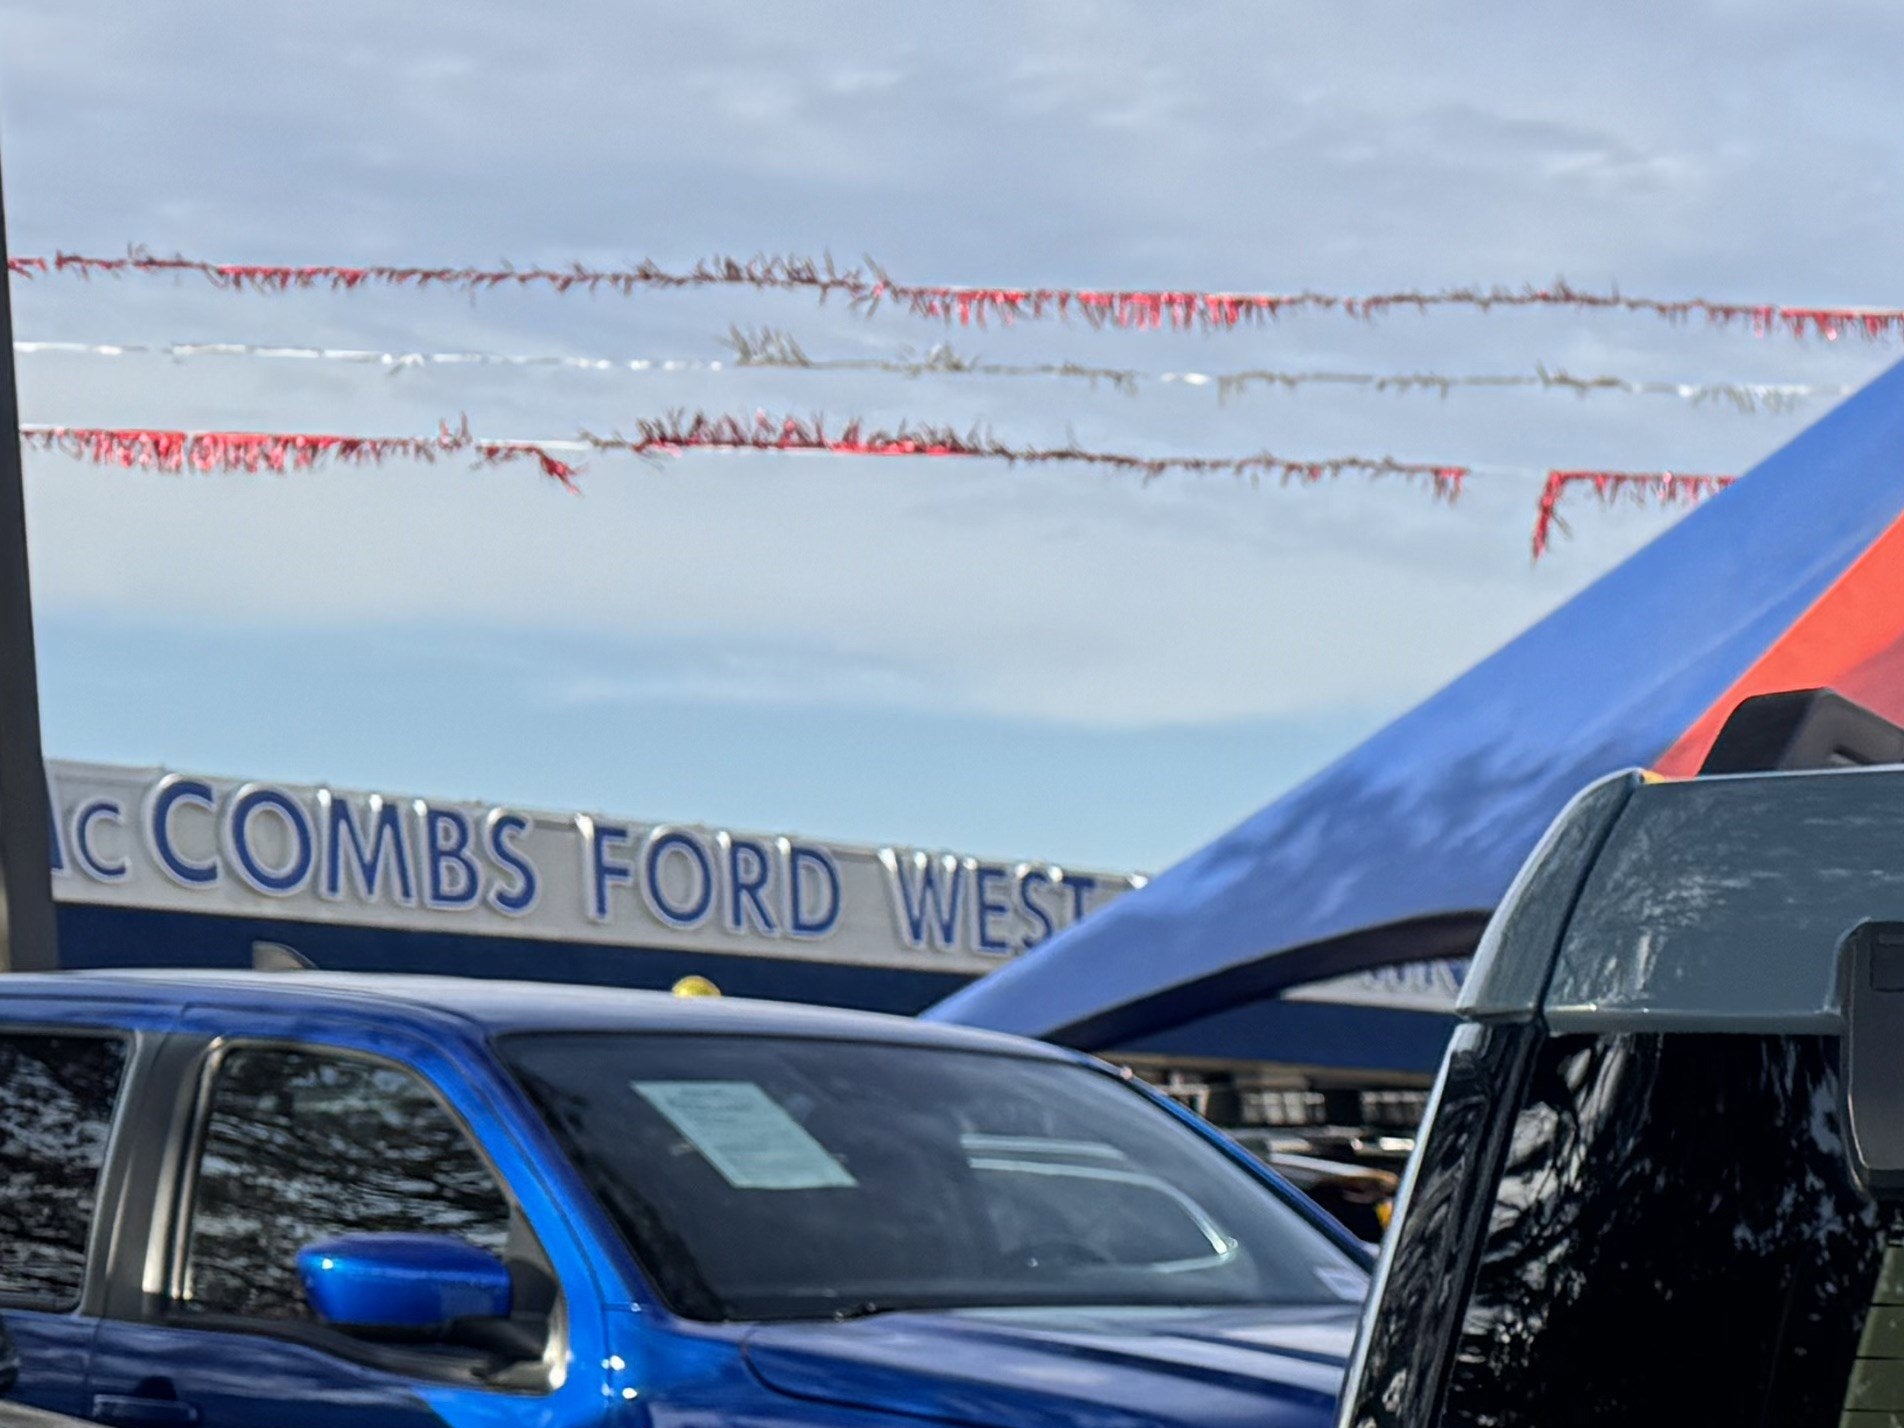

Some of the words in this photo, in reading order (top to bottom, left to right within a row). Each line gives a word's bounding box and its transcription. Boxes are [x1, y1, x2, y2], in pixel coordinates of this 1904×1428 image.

[51, 773, 540, 916] cCOMBS
[574, 811, 844, 939] FORD
[878, 848, 1098, 957] WEST
